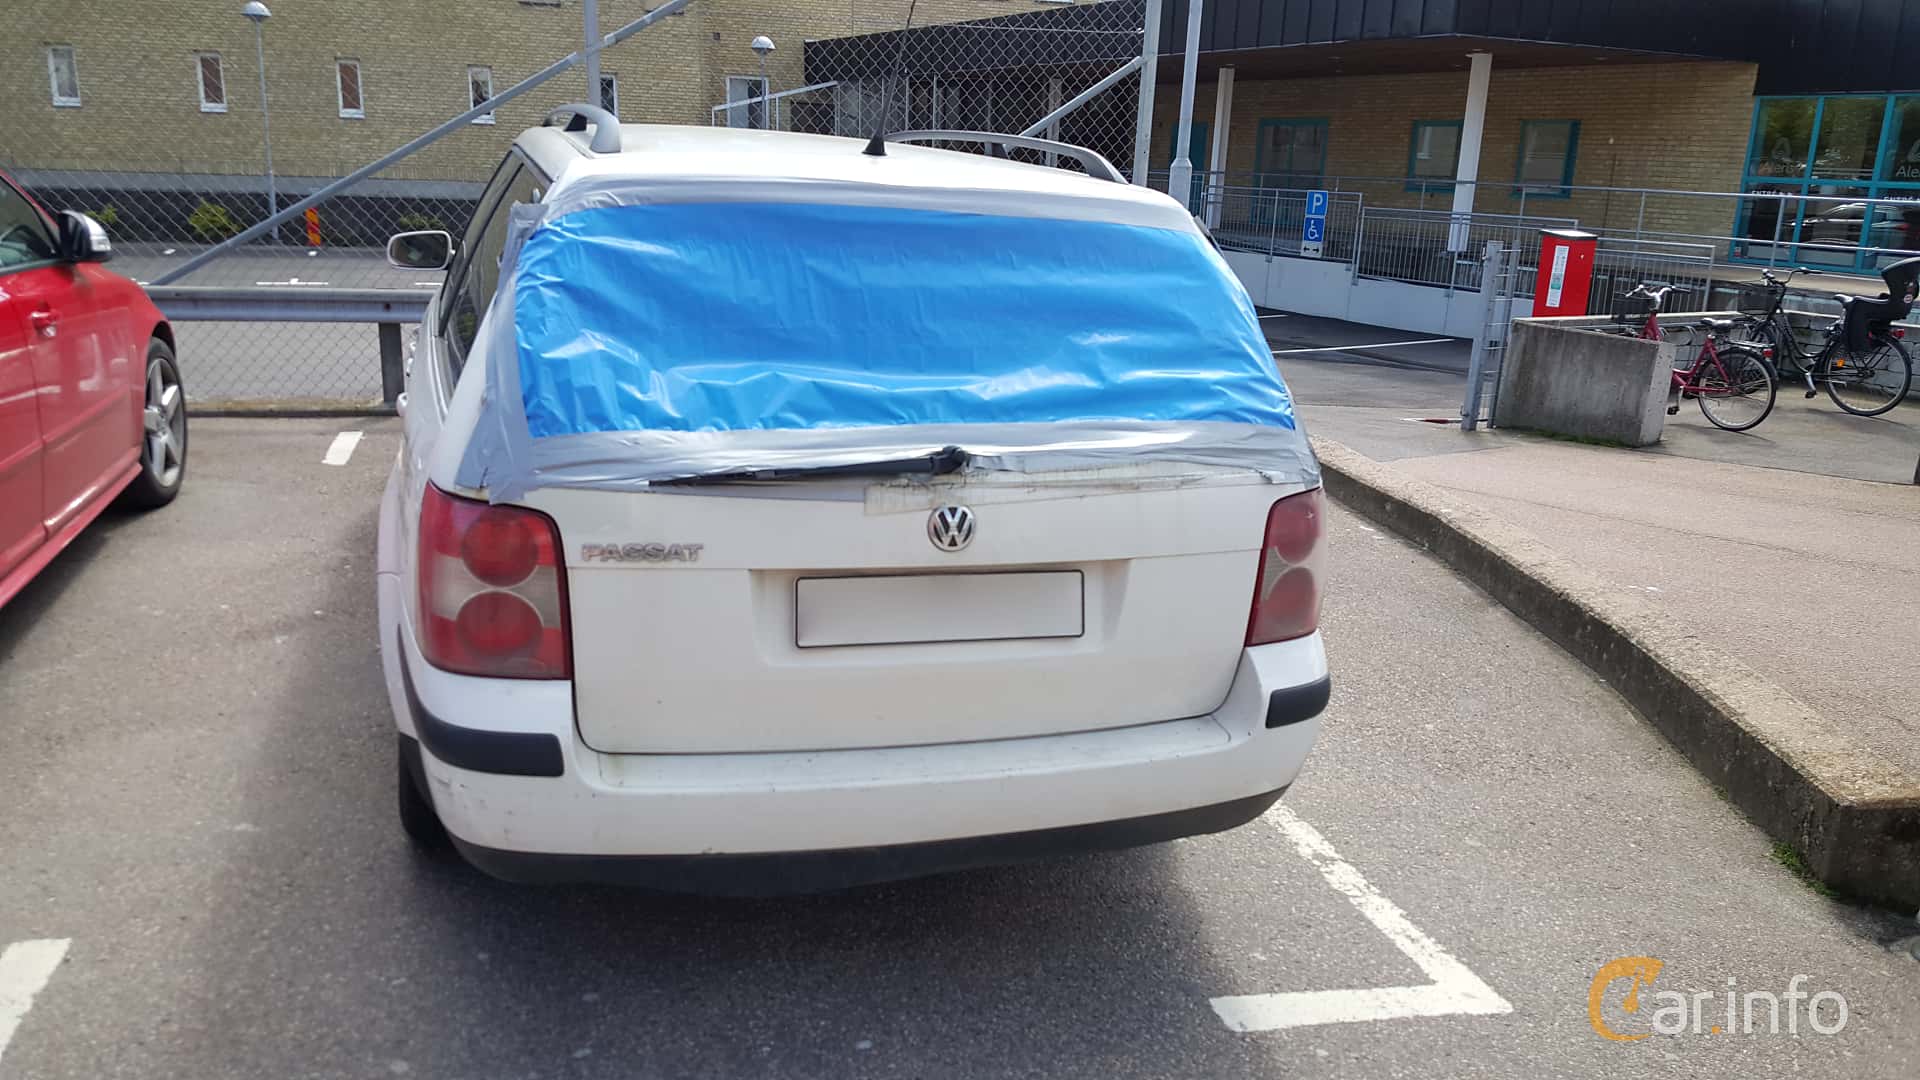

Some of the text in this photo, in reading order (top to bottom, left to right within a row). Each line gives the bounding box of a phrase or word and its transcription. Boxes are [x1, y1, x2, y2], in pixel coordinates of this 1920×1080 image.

[1895, 164, 1920, 178] Ale
[1311, 193, 1323, 214] P
[581, 543, 704, 562] PASSAT
